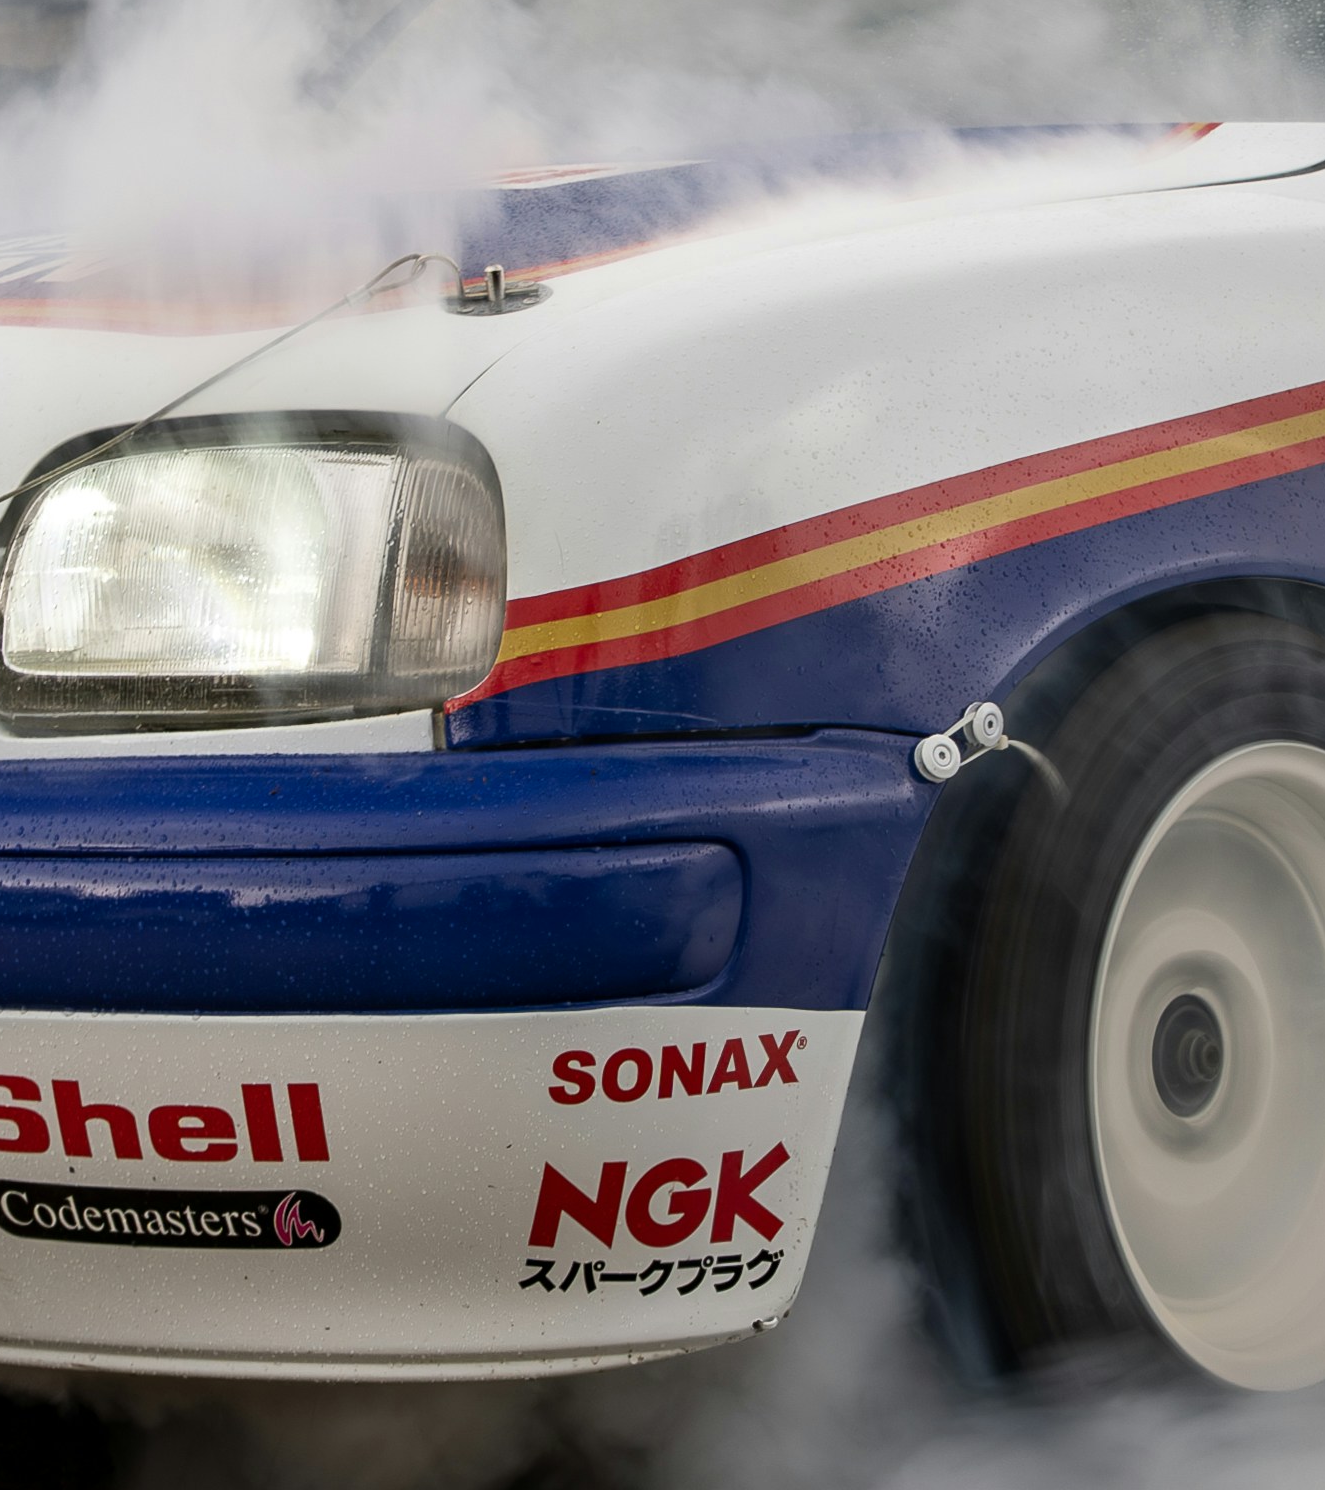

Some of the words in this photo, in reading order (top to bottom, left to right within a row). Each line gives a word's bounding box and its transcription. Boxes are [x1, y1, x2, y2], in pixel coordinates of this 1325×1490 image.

[548, 1029, 801, 1105] SONAX
[0, 1190, 263, 1237] Codemasters
[528, 1141, 791, 1250] NGK
[518, 1249, 785, 1297] スパークプラグ
